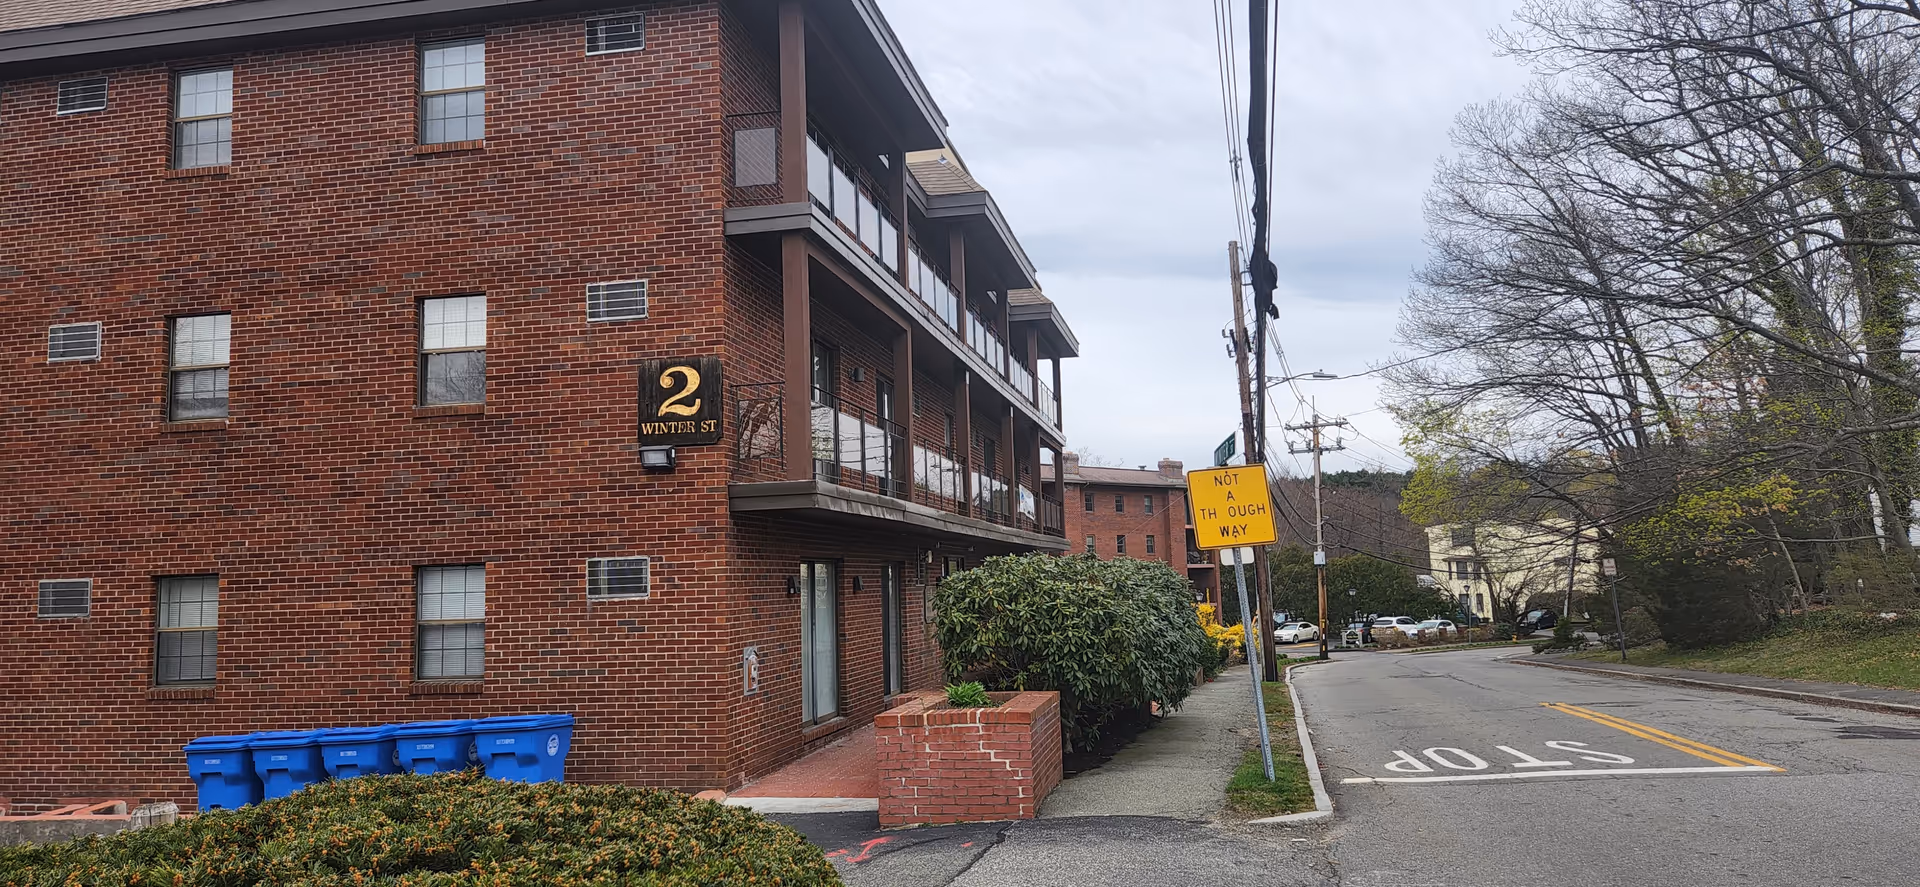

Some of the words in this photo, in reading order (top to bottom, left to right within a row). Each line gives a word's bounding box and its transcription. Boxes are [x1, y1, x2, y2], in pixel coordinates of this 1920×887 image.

[657, 365, 702, 417] 2
[641, 421, 696, 435] WINTER
[700, 419, 717, 433] ST
[1213, 473, 1240, 487] NOT
[1226, 490, 1236, 502] A
[1219, 523, 1249, 538] WAY
[1383, 739, 1636, 773] STOP
